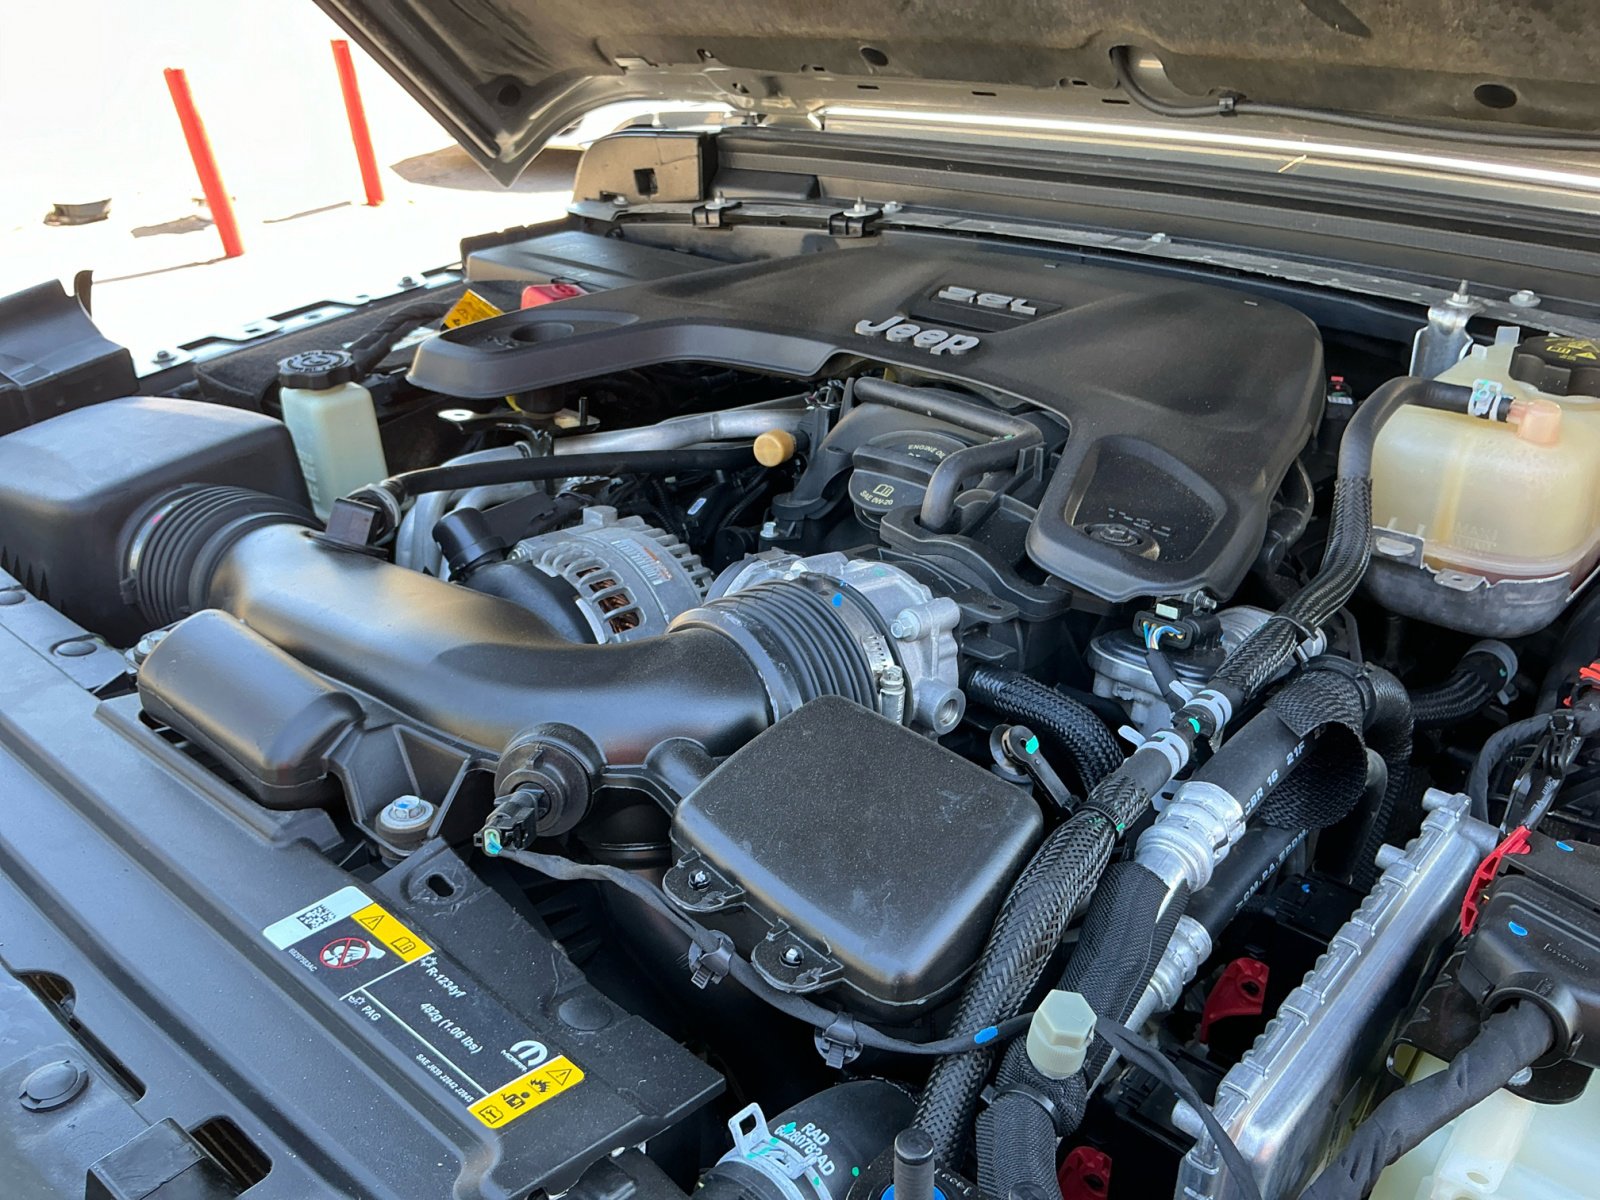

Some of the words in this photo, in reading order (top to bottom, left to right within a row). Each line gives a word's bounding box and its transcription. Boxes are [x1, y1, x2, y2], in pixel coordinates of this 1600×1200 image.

[855, 316, 980, 355] Jeep
[908, 444, 937, 454] ENGINE
[860, 490, 873, 501] SAE
[425, 966, 467, 999] R-1234yf
[361, 1005, 382, 1022] PAG
[420, 1002, 443, 1023] 482g
[438, 1018, 462, 1039] (1.06
[460, 1034, 484, 1055] lbs)
[415, 1053, 431, 1066] SAE
[801, 1122, 830, 1145] RAD
